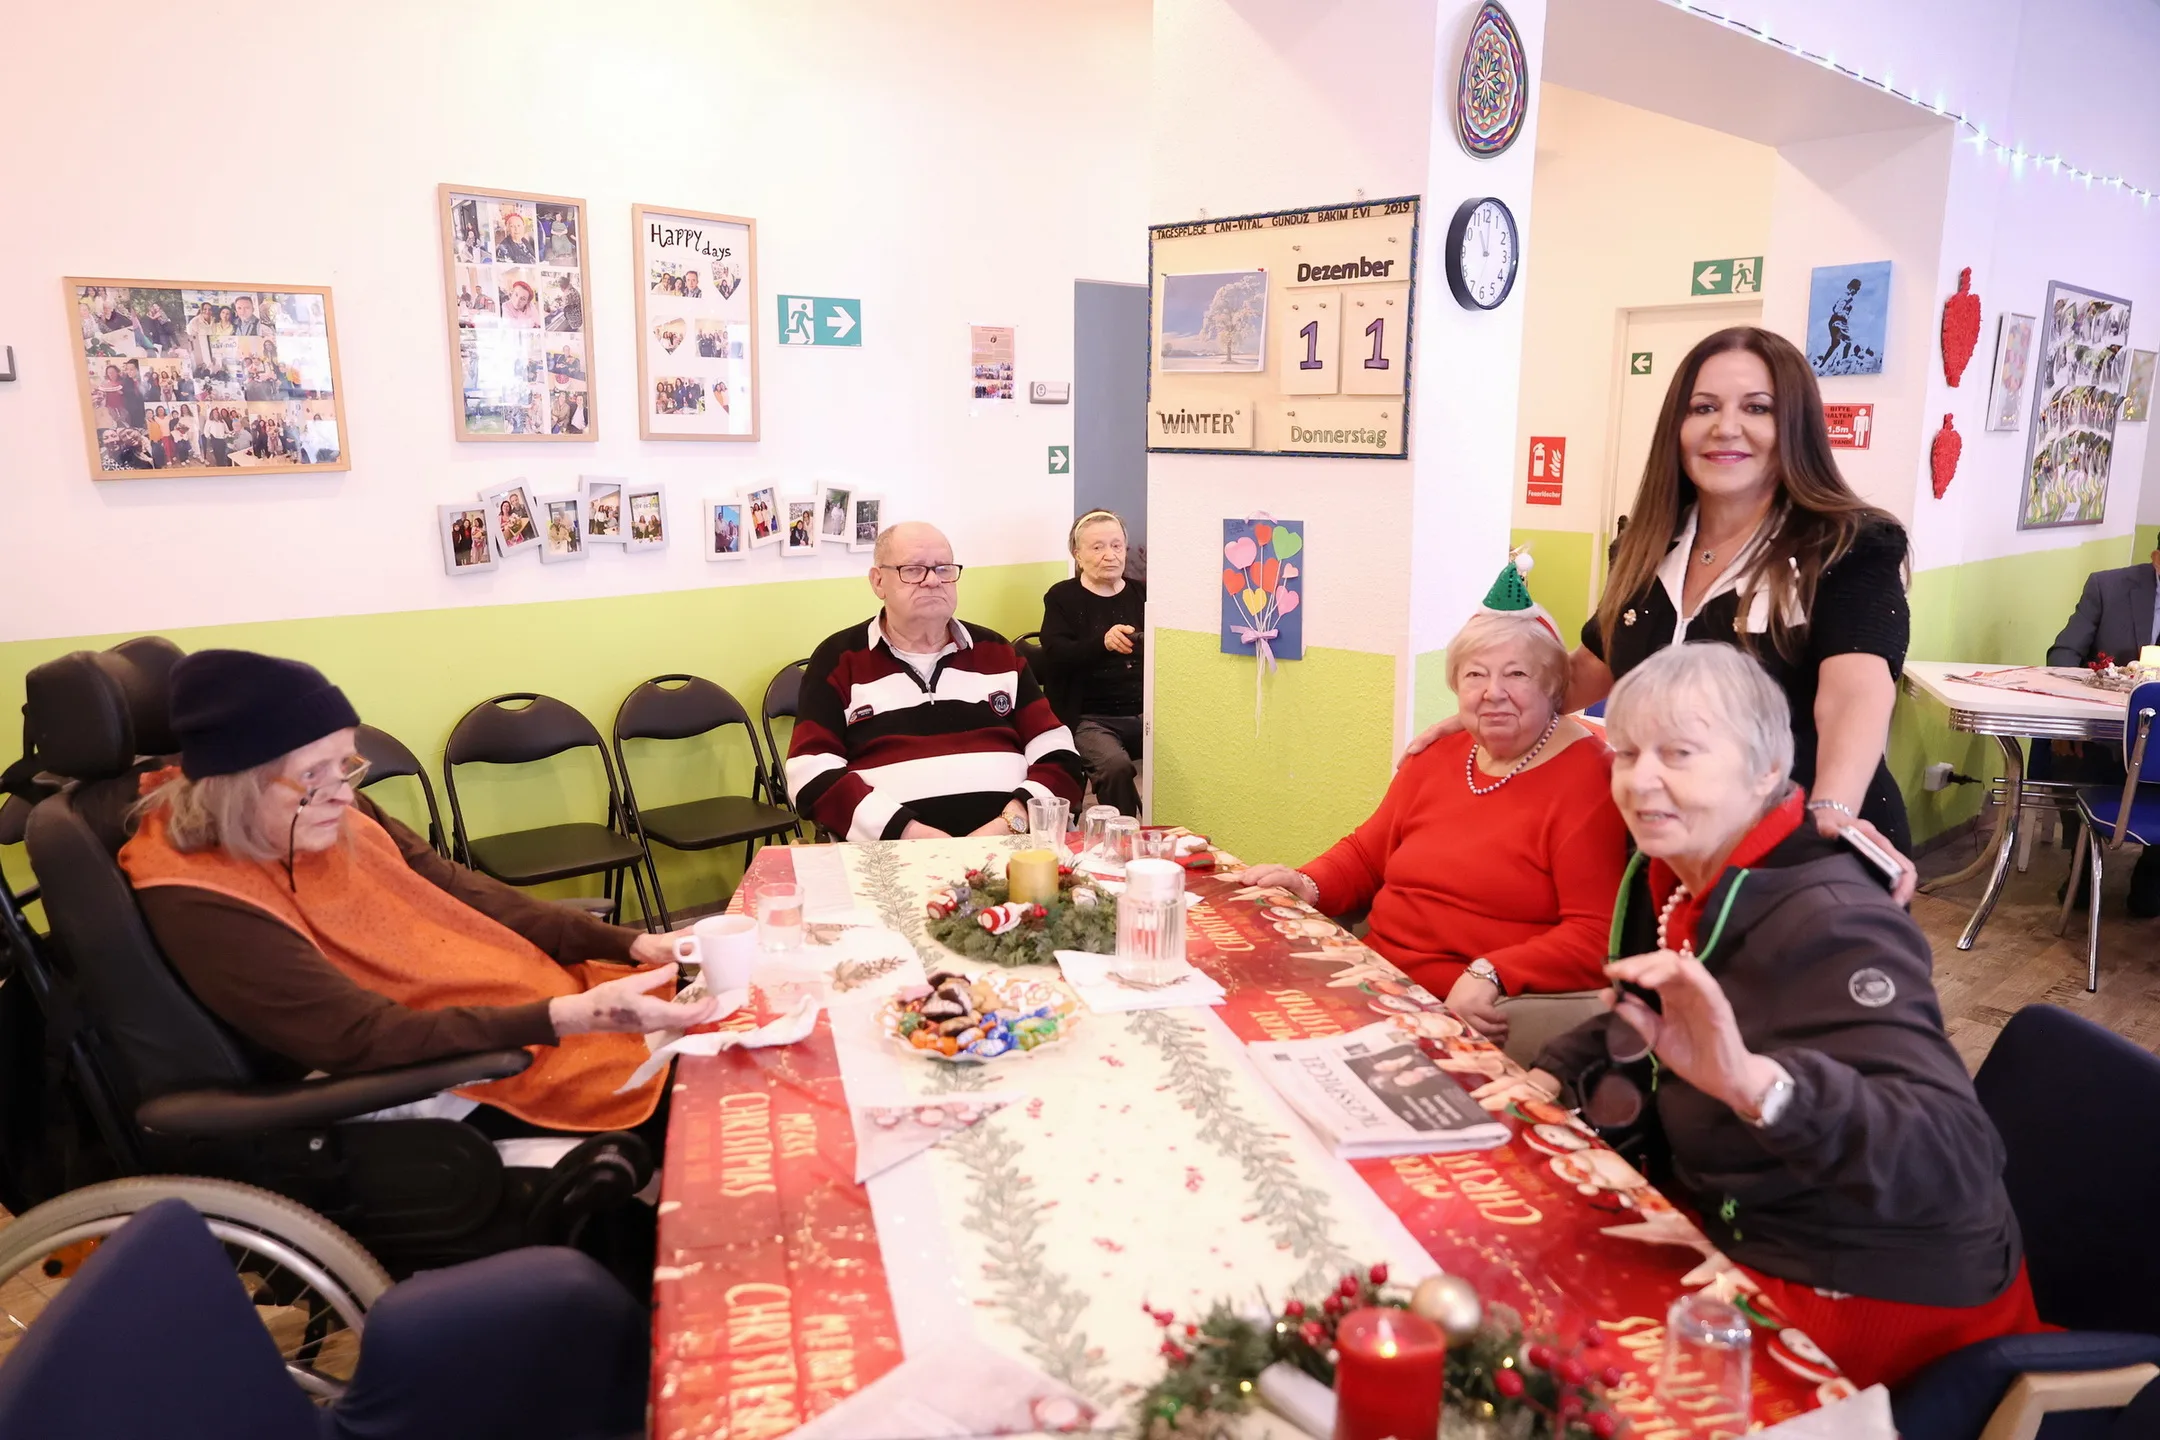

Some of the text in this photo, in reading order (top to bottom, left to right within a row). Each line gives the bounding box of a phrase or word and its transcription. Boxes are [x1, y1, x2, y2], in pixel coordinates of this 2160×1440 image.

[1157, 225, 1207, 240] TAGESPFLEGE
[1317, 208, 1348, 222] BAKIM
[1384, 202, 1410, 216] 2019
[1483, 208, 1492, 224] 12
[1500, 231, 1506, 246] 2
[701, 240, 732, 261] days
[1502, 250, 1508, 264] 3
[1297, 256, 1394, 282] Dezember
[1498, 268, 1504, 282] 4
[1470, 279, 1476, 294] 7
[1479, 286, 1485, 300] 6
[1490, 282, 1495, 296] 5
[1290, 426, 1388, 449] Donnerstag
[1265, 990, 1346, 1039] RISTMAS
[720, 1092, 777, 1198] CHRISTMAS
[1428, 1152, 1544, 1226] CHRIST
